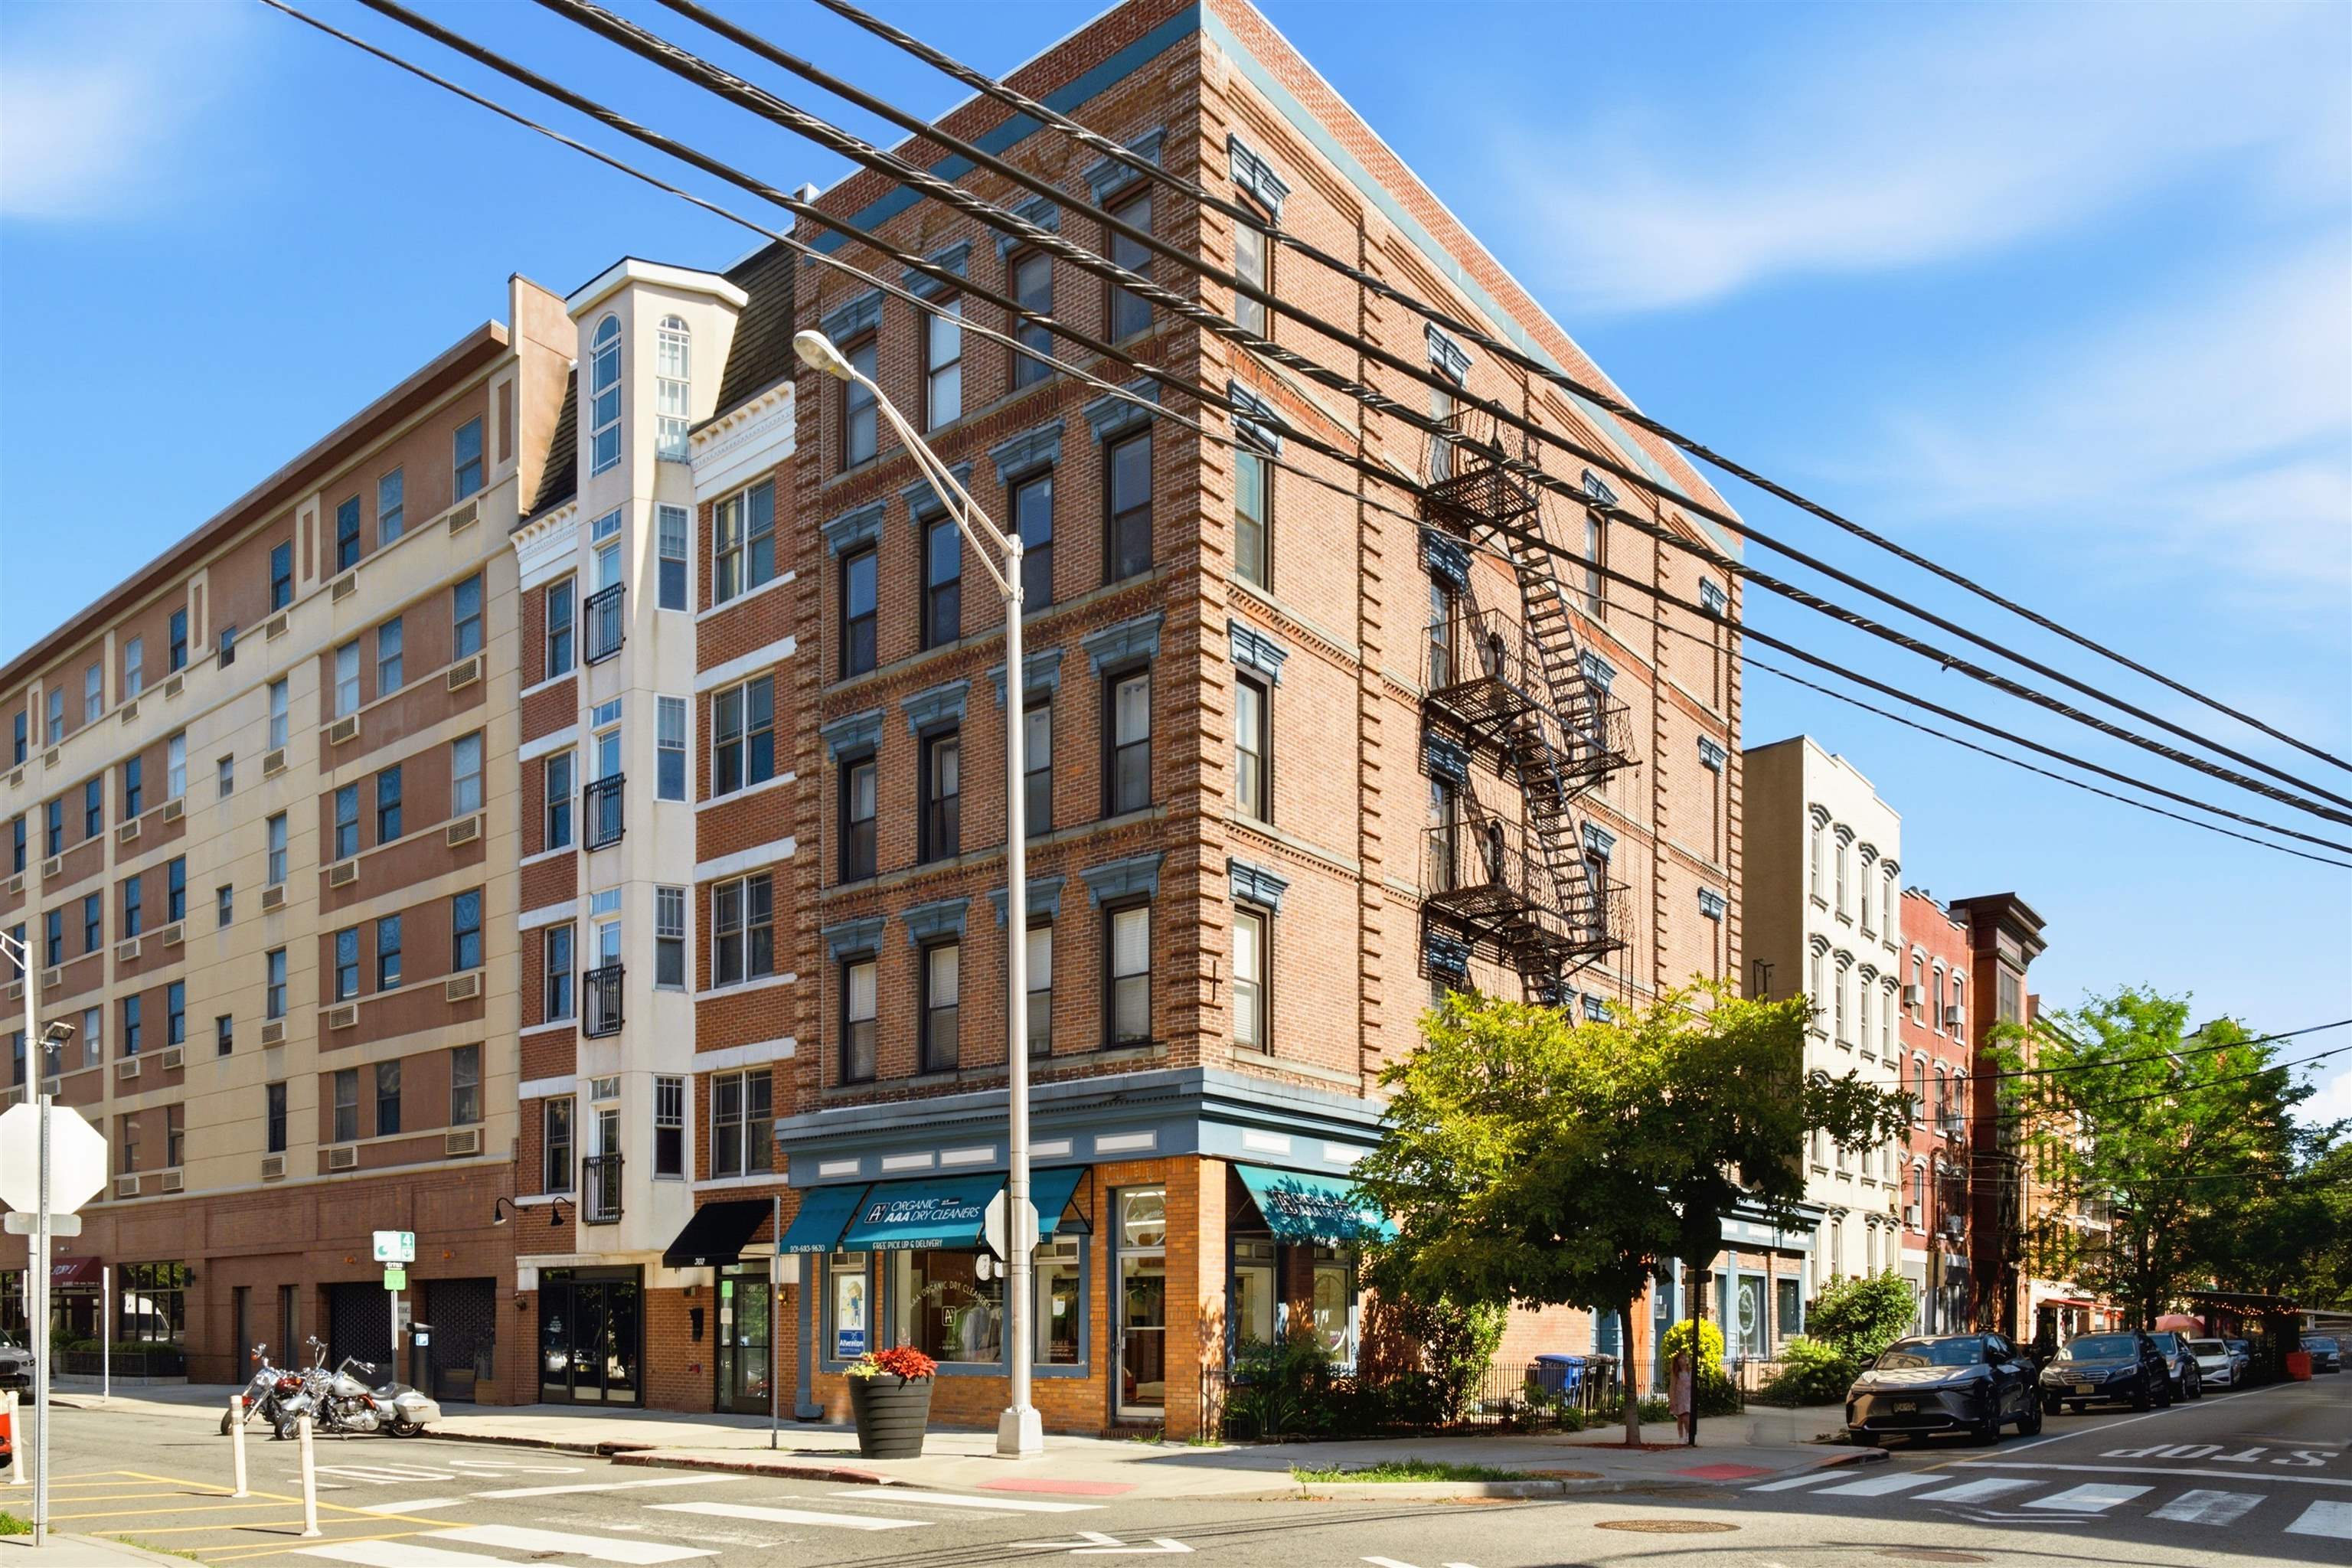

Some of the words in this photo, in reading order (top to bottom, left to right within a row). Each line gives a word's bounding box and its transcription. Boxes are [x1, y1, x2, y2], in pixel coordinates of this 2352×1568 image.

[891, 1199, 939, 1212] ORGANIC
[884, 1212, 909, 1223] AAA
[910, 1209, 931, 1221] DRY
[931, 1207, 980, 1220] CLEANERS
[403, 1233, 412, 1246] 4
[873, 1242, 886, 1250] FREE
[915, 1239, 942, 1248] DELIVERY
[2099, 1444, 2339, 1467] STOP
